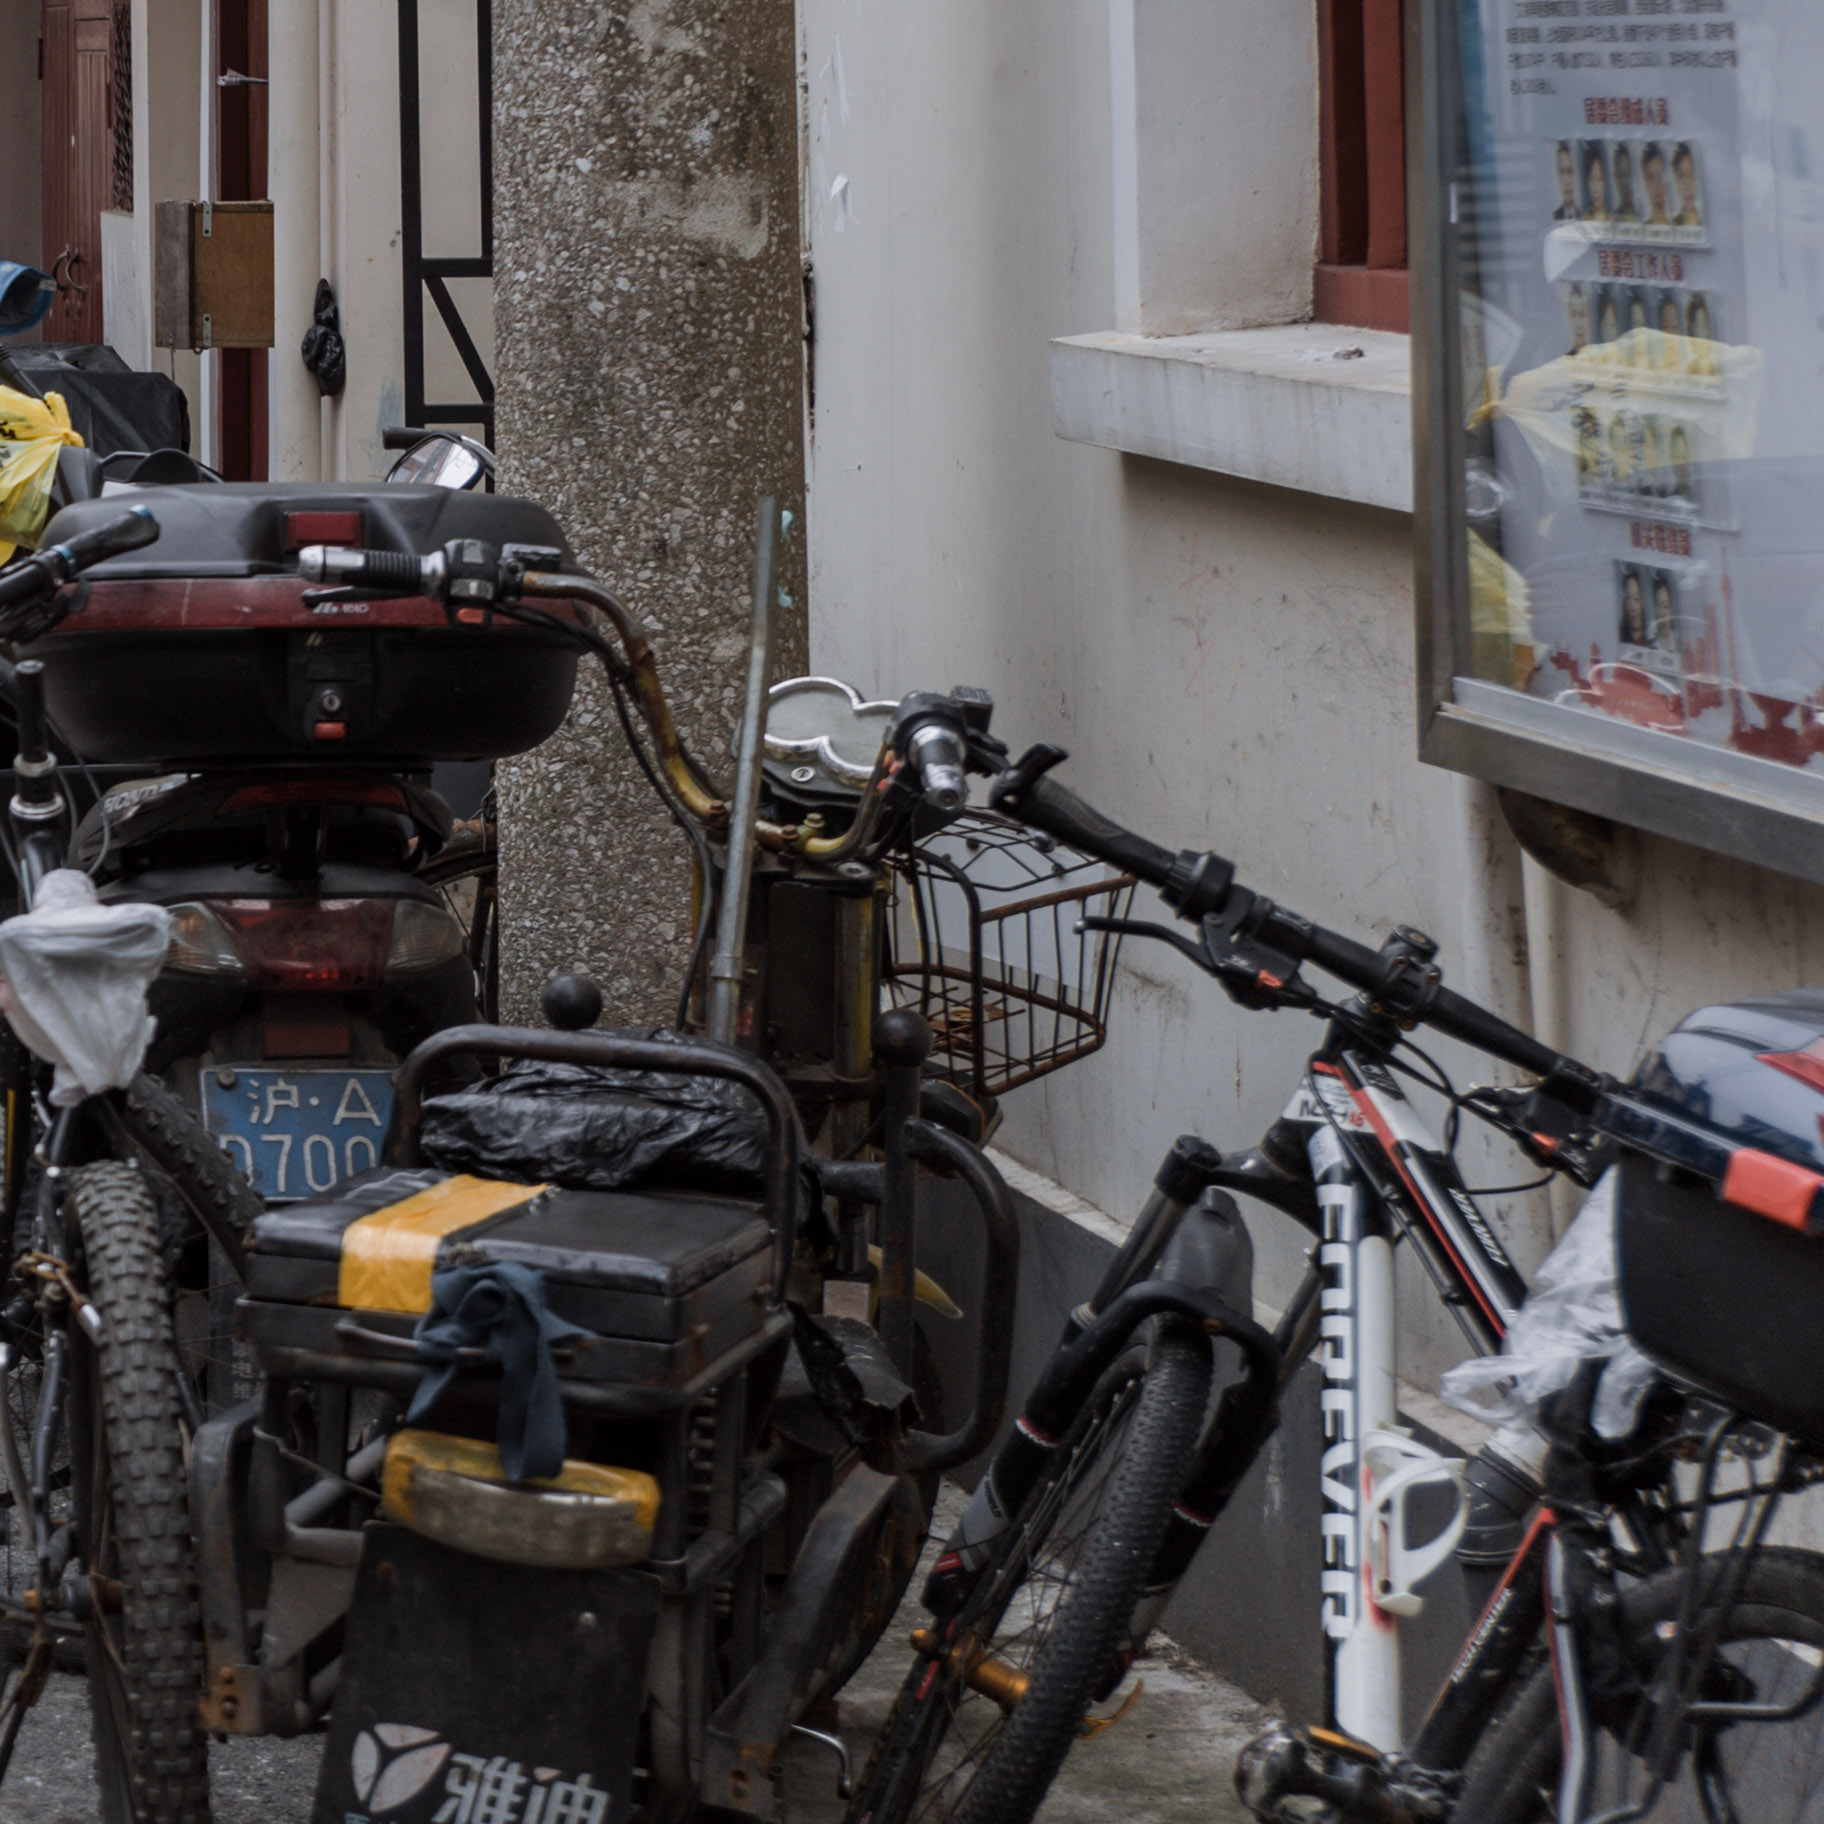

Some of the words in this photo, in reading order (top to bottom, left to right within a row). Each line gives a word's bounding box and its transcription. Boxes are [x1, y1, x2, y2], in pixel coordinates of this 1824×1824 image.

[247, 1077, 384, 1127] 沪·A
[1318, 1183, 1356, 1639] FOREVER
[430, 1751, 613, 1824] 雅迪
